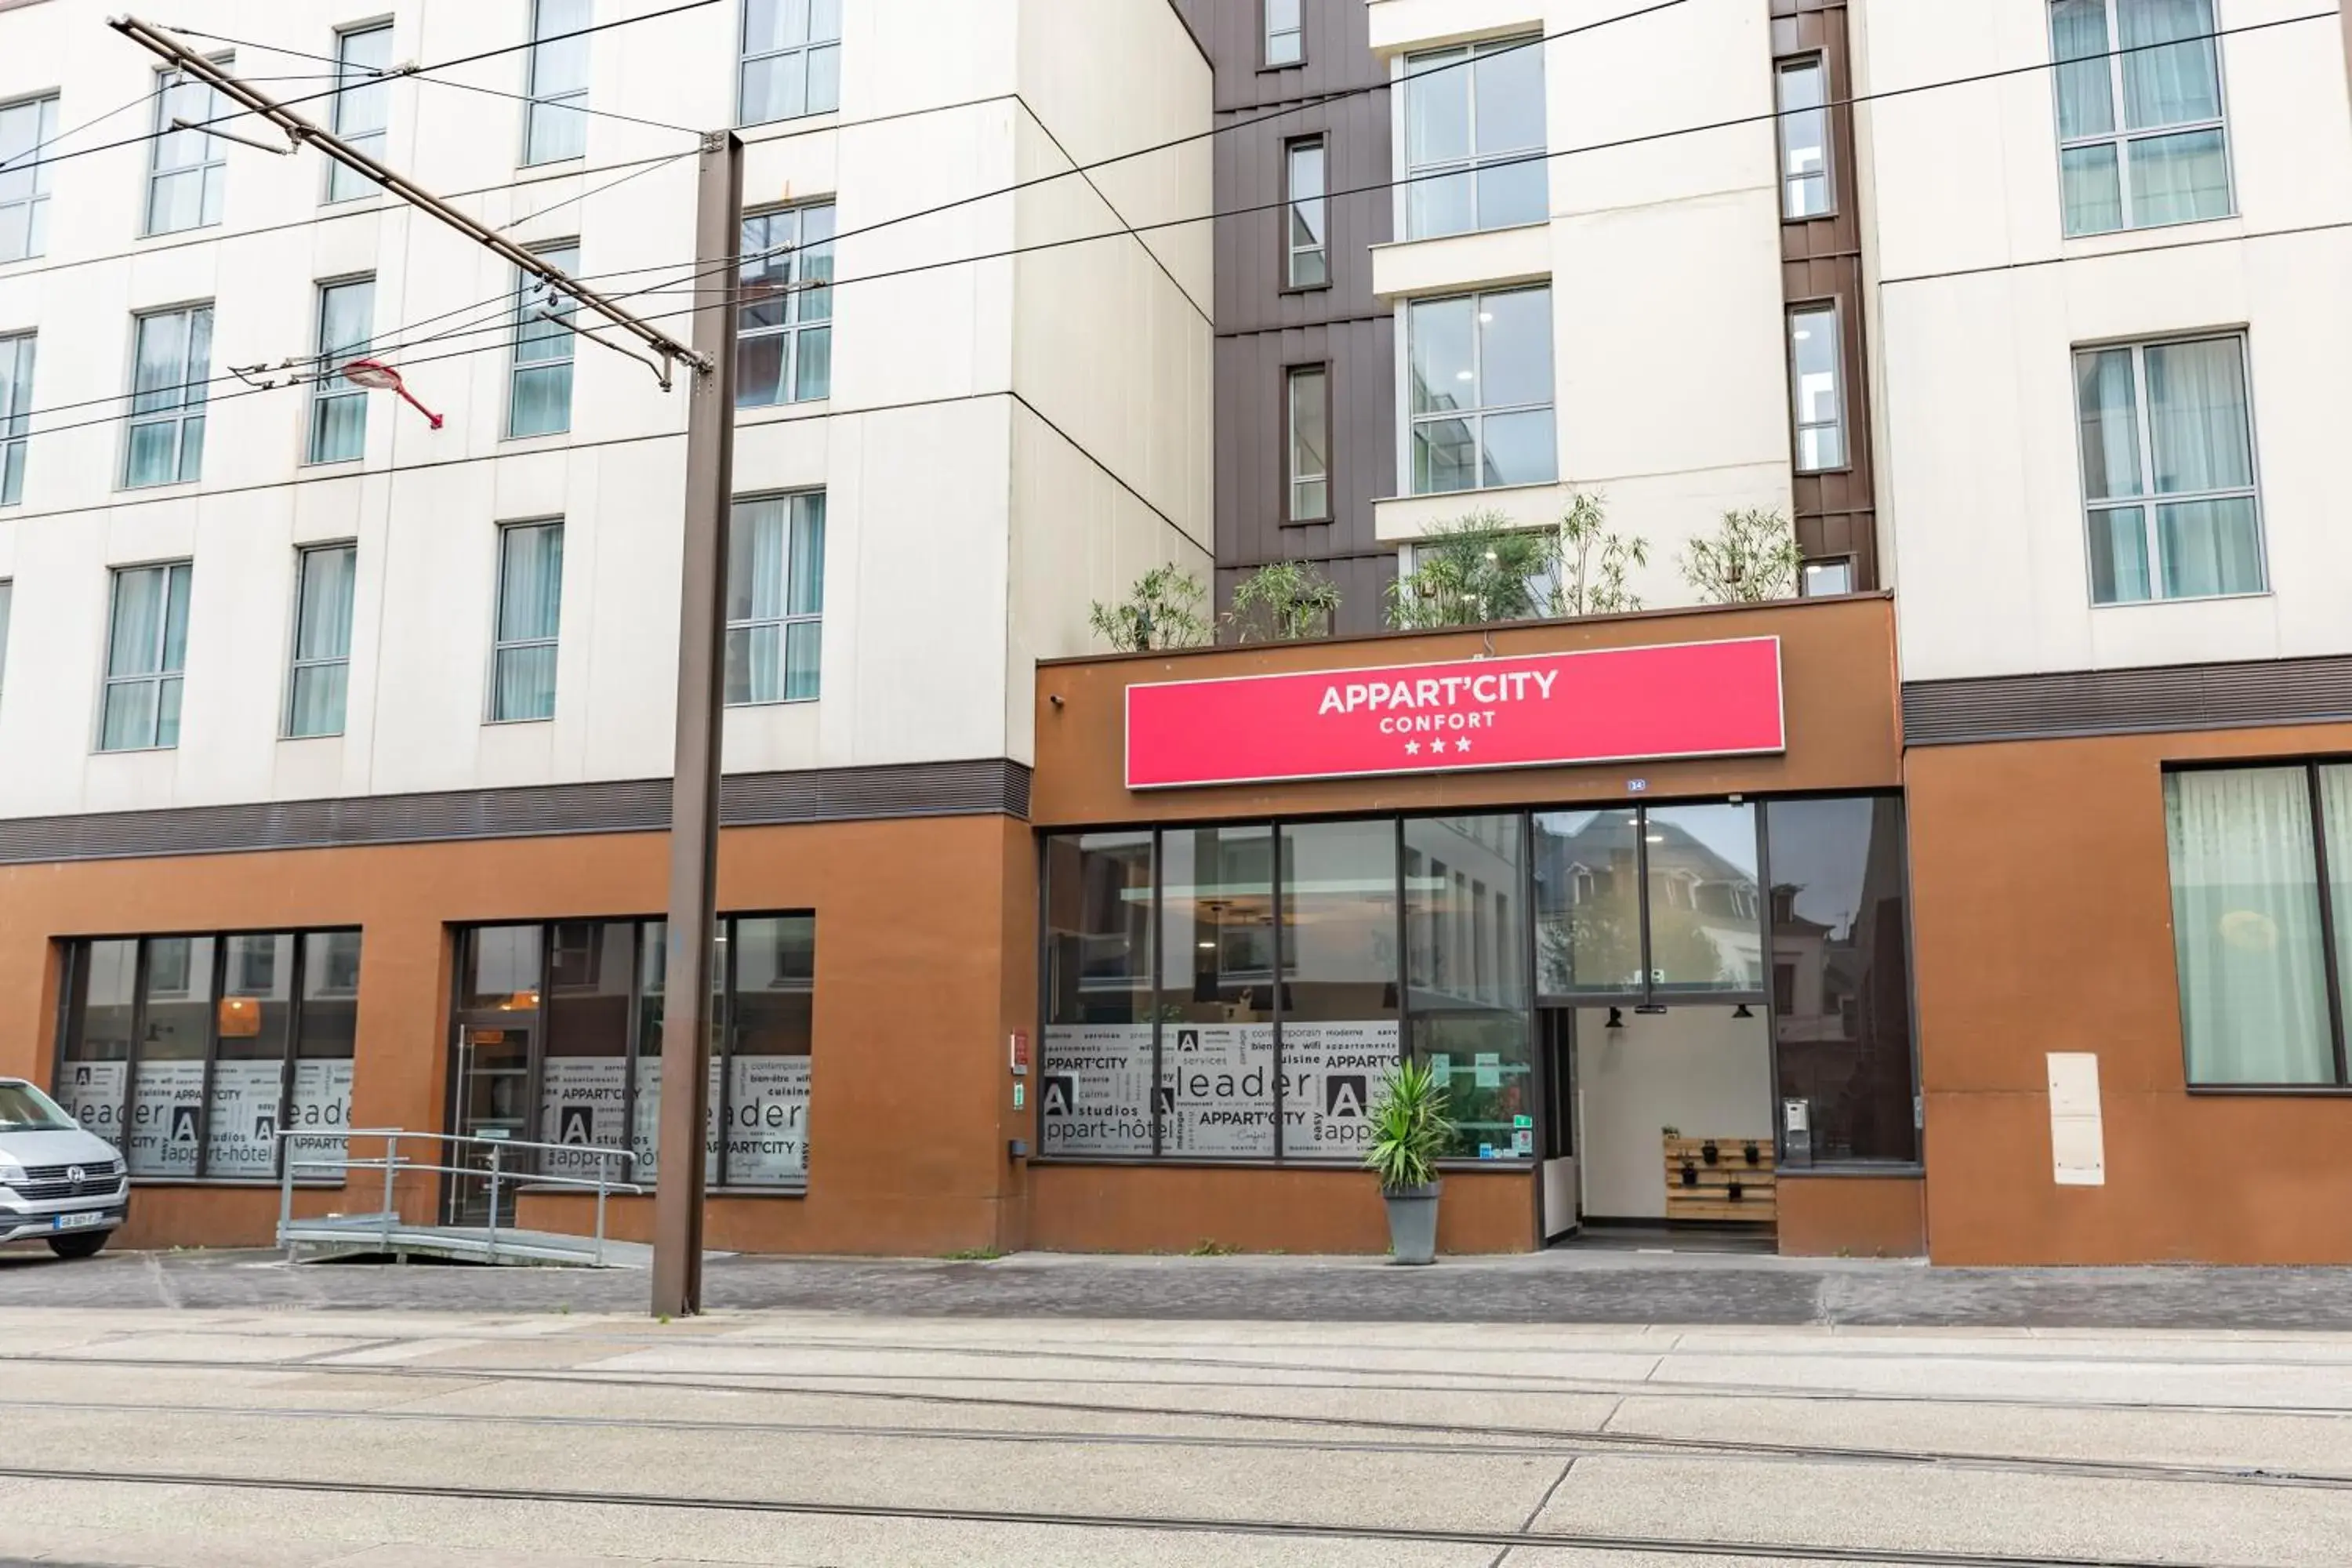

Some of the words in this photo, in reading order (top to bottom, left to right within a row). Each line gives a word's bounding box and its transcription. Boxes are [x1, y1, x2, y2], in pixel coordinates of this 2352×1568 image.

[1318, 669, 1559, 715] APPART'CITY
[1379, 710, 1495, 734] CONFORT
[1045, 1058, 1127, 1069] PPART'CITY
[1078, 1104, 1138, 1116] studios
